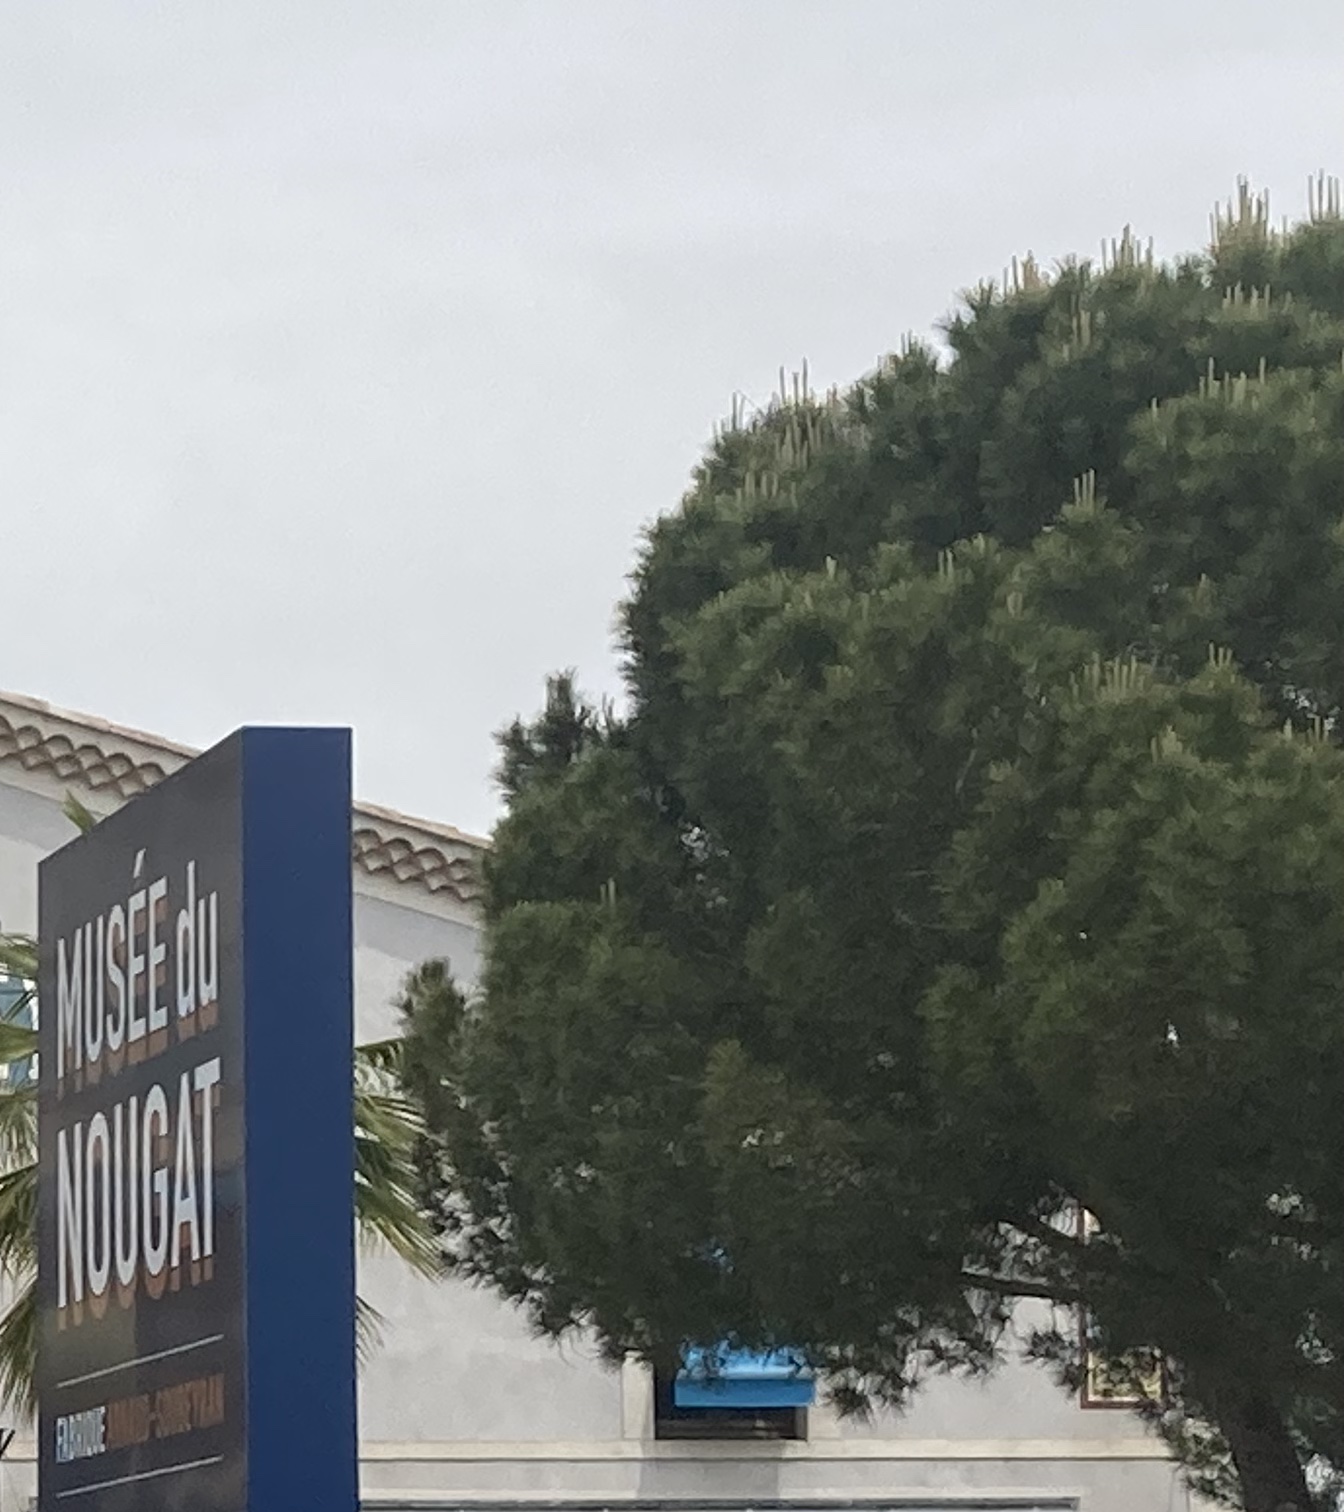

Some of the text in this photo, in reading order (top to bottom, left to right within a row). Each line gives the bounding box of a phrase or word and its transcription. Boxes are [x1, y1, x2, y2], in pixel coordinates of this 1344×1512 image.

[56, 850, 219, 1080] MUSÉE du
[56, 1057, 222, 1308] NOUGAT
